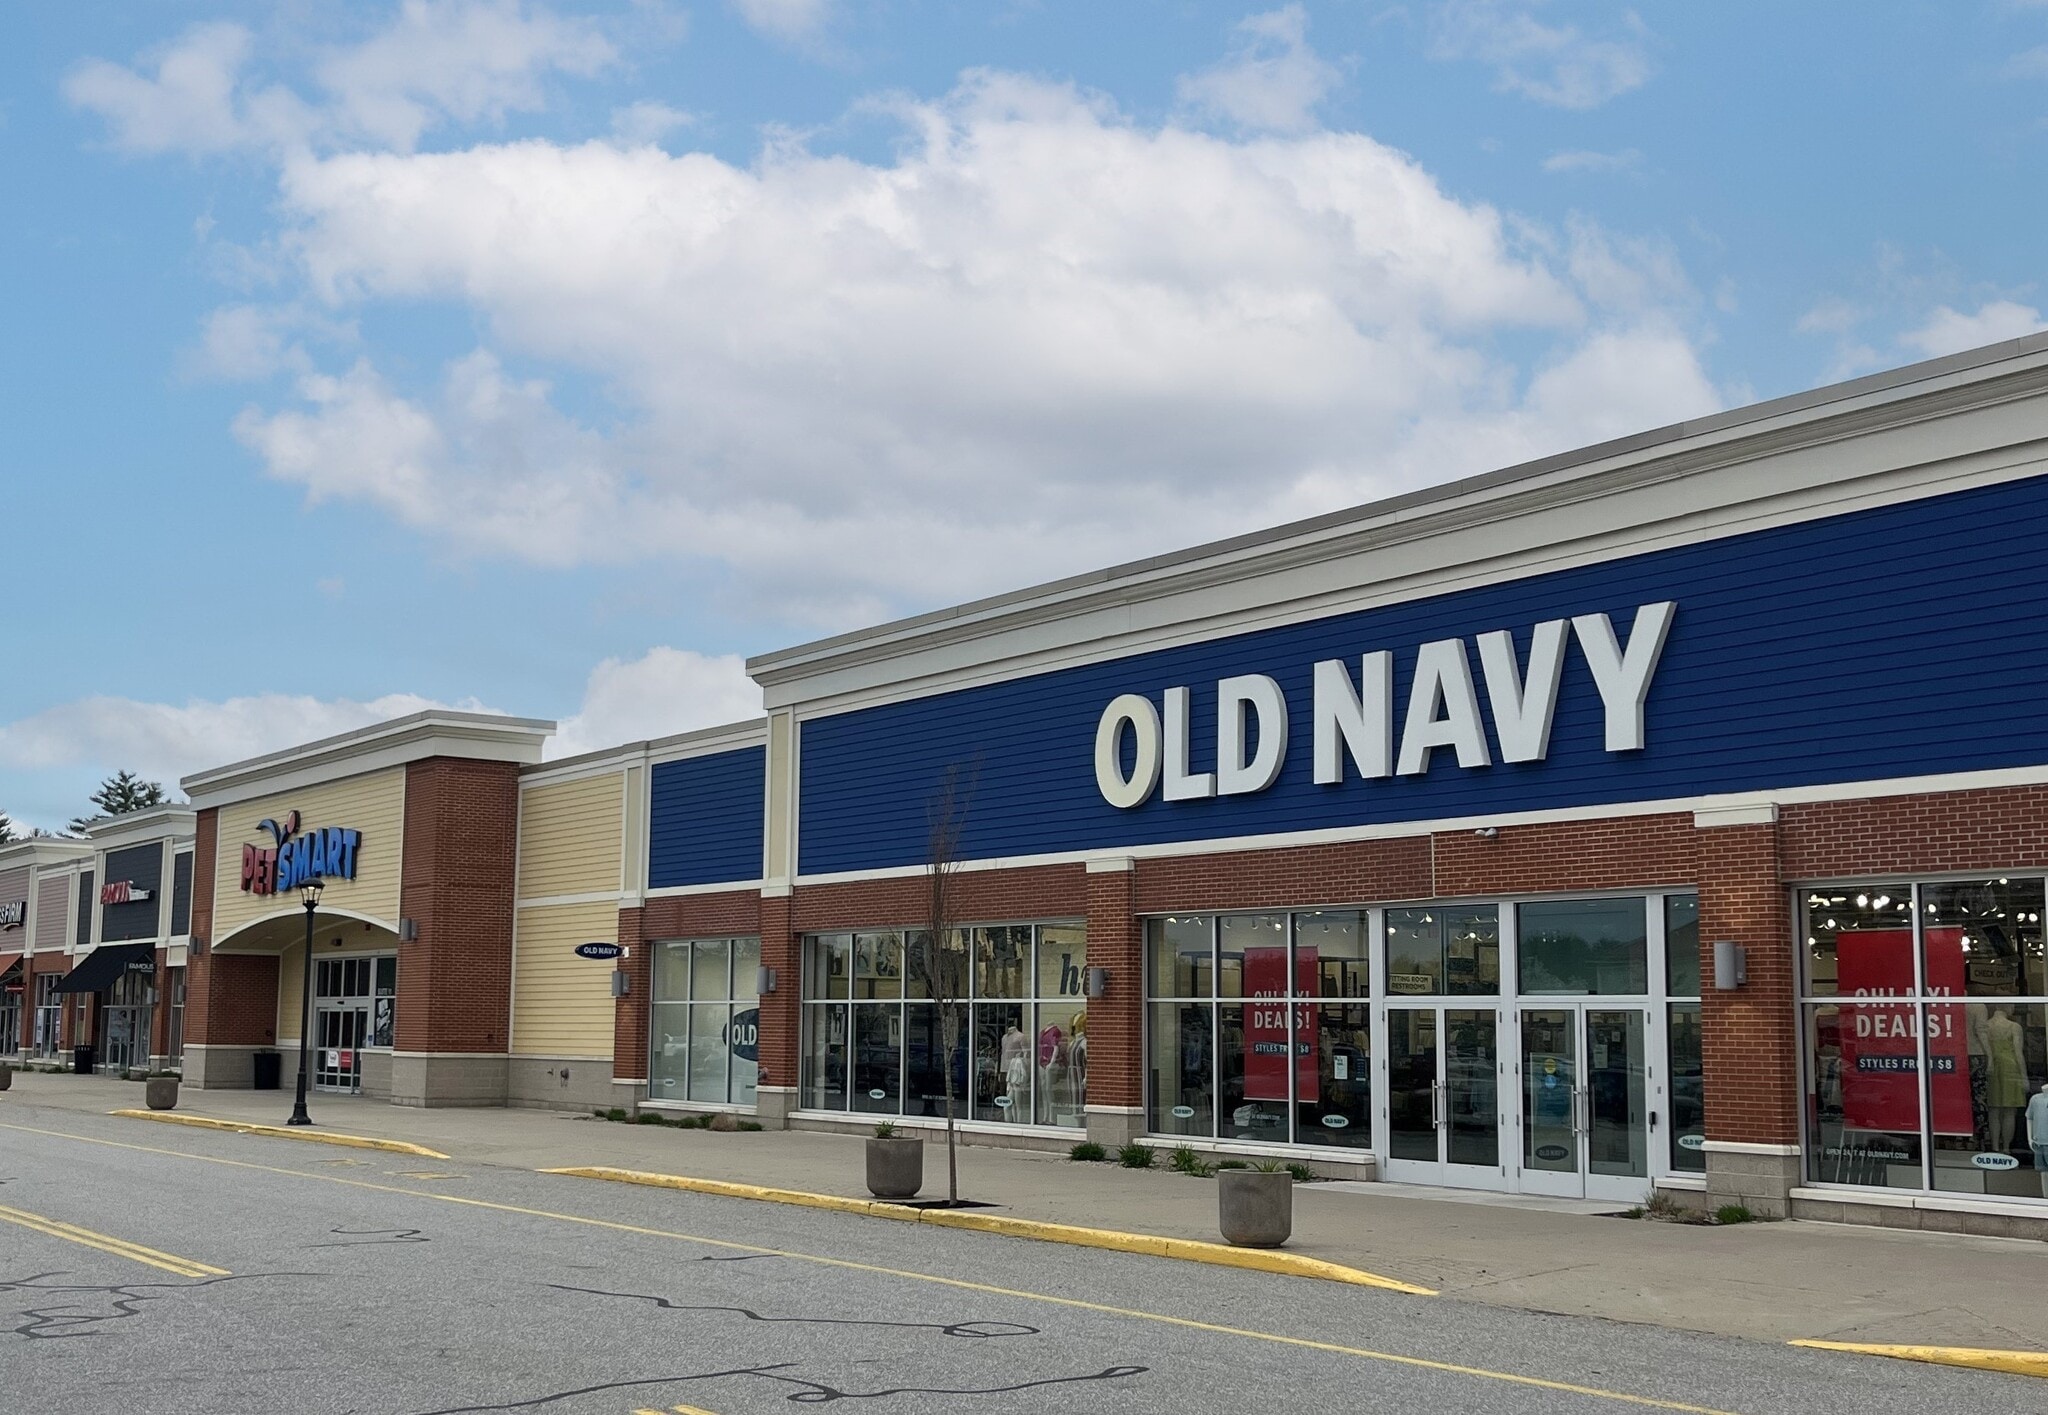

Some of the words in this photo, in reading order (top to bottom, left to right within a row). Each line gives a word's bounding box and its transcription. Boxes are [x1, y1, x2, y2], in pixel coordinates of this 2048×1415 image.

[1094, 673, 1288, 808] OLD
[1313, 601, 1677, 785] NAVY
[241, 826, 362, 895] PETSMART
[583, 946, 598, 954] OLD
[598, 947, 618, 955] NAVY
[1391, 975, 1411, 983] ITTING
[1391, 982, 1426, 991] RESTROOMS
[1855, 987, 1895, 1008] OH!
[1254, 1011, 1310, 1029] DEALS!
[1855, 1014, 1953, 1038] DEALS!
[733, 1024, 757, 1046] OLD
[1255, 1044, 1278, 1052] STYLES
[1859, 1058, 1899, 1069] STYLES
[1902, 1059, 1934, 1069] FR
[1937, 1059, 1953, 1070] $8
[1976, 1156, 1992, 1164] OLD
[1992, 1158, 2013, 1166] NAVY
